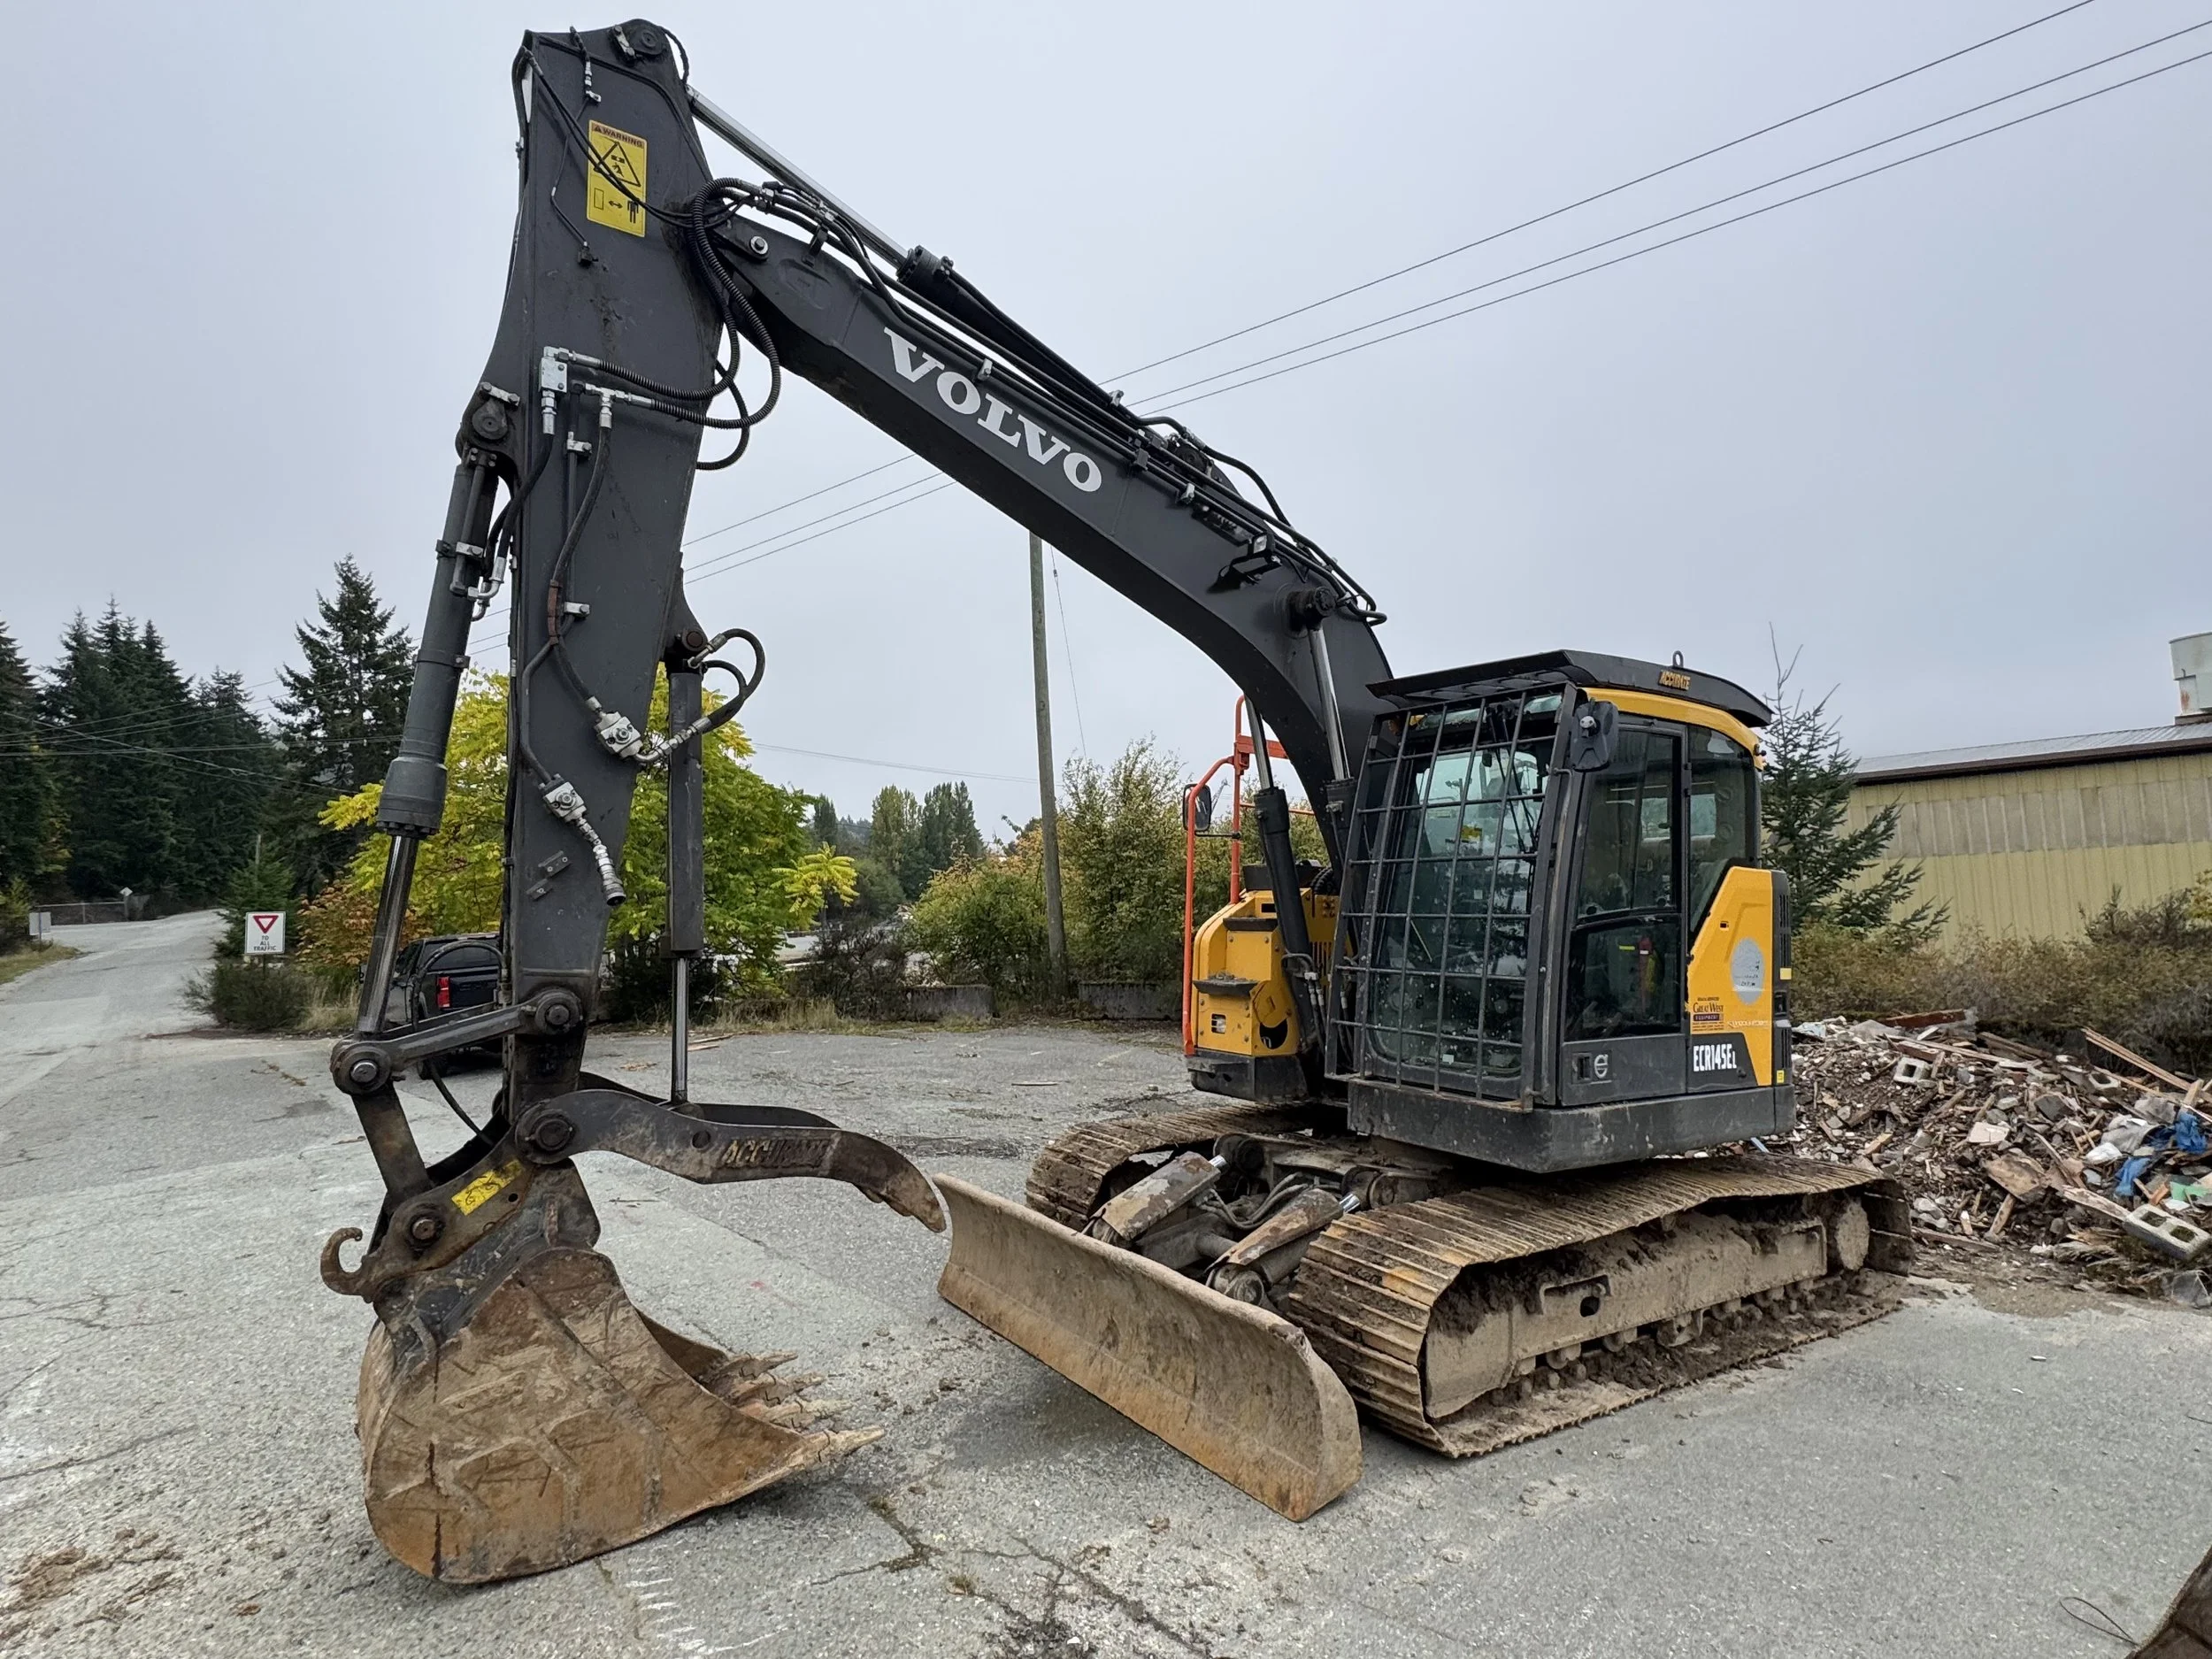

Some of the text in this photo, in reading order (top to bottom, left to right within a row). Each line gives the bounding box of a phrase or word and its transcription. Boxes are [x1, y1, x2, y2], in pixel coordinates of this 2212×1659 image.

[603, 127, 643, 147] WARNING
[884, 326, 1102, 492] VOLVO
[1659, 670, 1691, 690] ACCURATE
